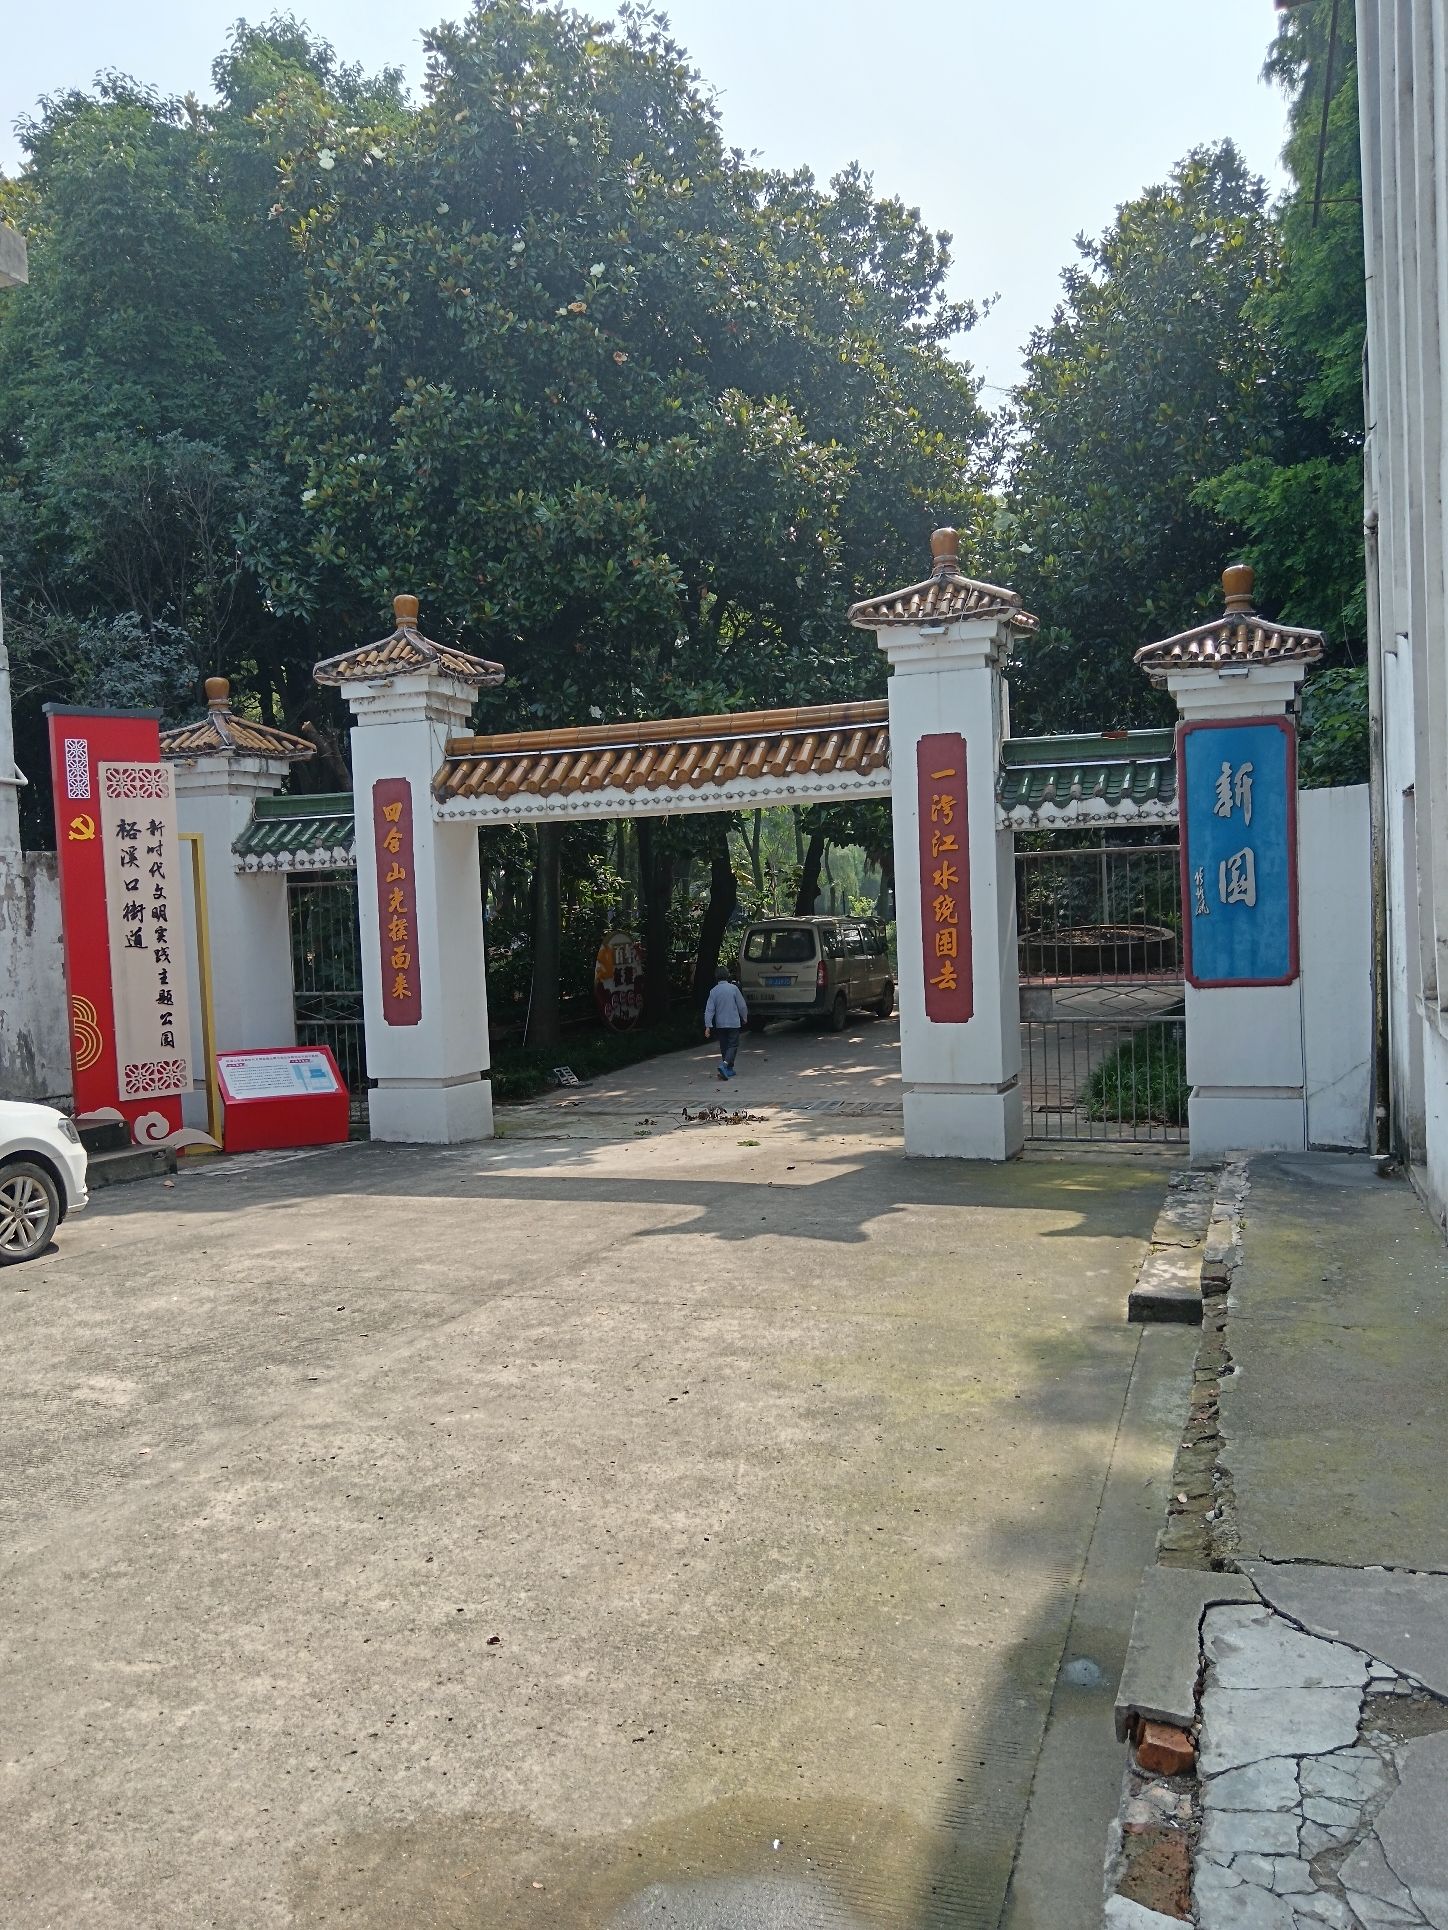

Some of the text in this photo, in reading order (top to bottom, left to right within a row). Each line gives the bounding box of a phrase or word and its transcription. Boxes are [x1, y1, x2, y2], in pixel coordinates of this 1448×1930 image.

[115, 818, 149, 949] 裕溪口街道
